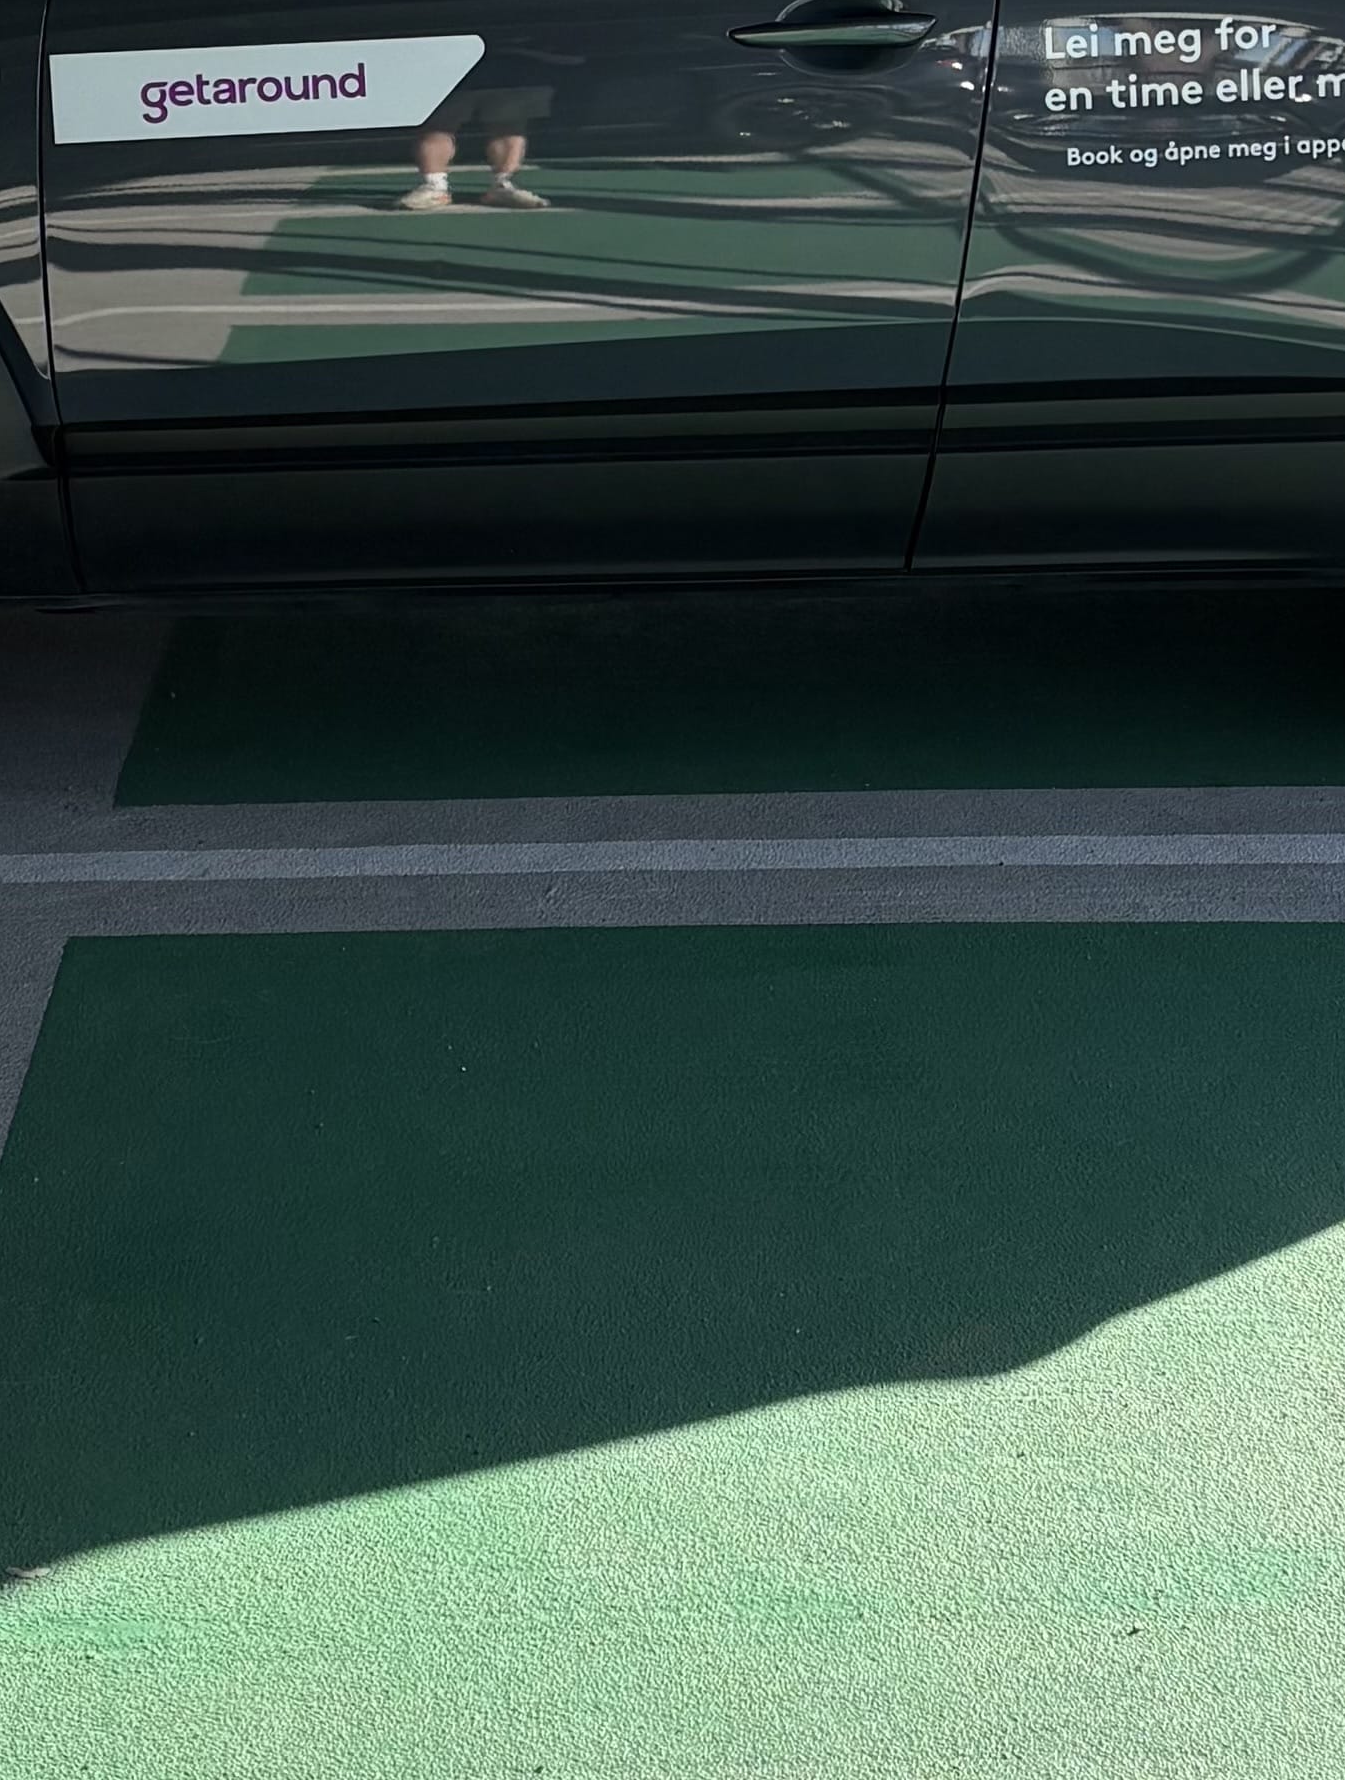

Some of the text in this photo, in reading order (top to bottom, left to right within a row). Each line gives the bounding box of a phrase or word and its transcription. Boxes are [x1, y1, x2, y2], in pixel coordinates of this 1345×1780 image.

[1044, 17, 1277, 63] Lei meg for
[140, 63, 367, 124] getaround
[1044, 85, 1093, 112] en
[1106, 74, 1204, 109] time
[1215, 68, 1304, 103] eller
[1066, 145, 1124, 167] Book
[1129, 146, 1158, 168] og
[1164, 141, 1221, 165] åpne
[1228, 142, 1277, 162] meg
[1283, 135, 1291, 155] i
